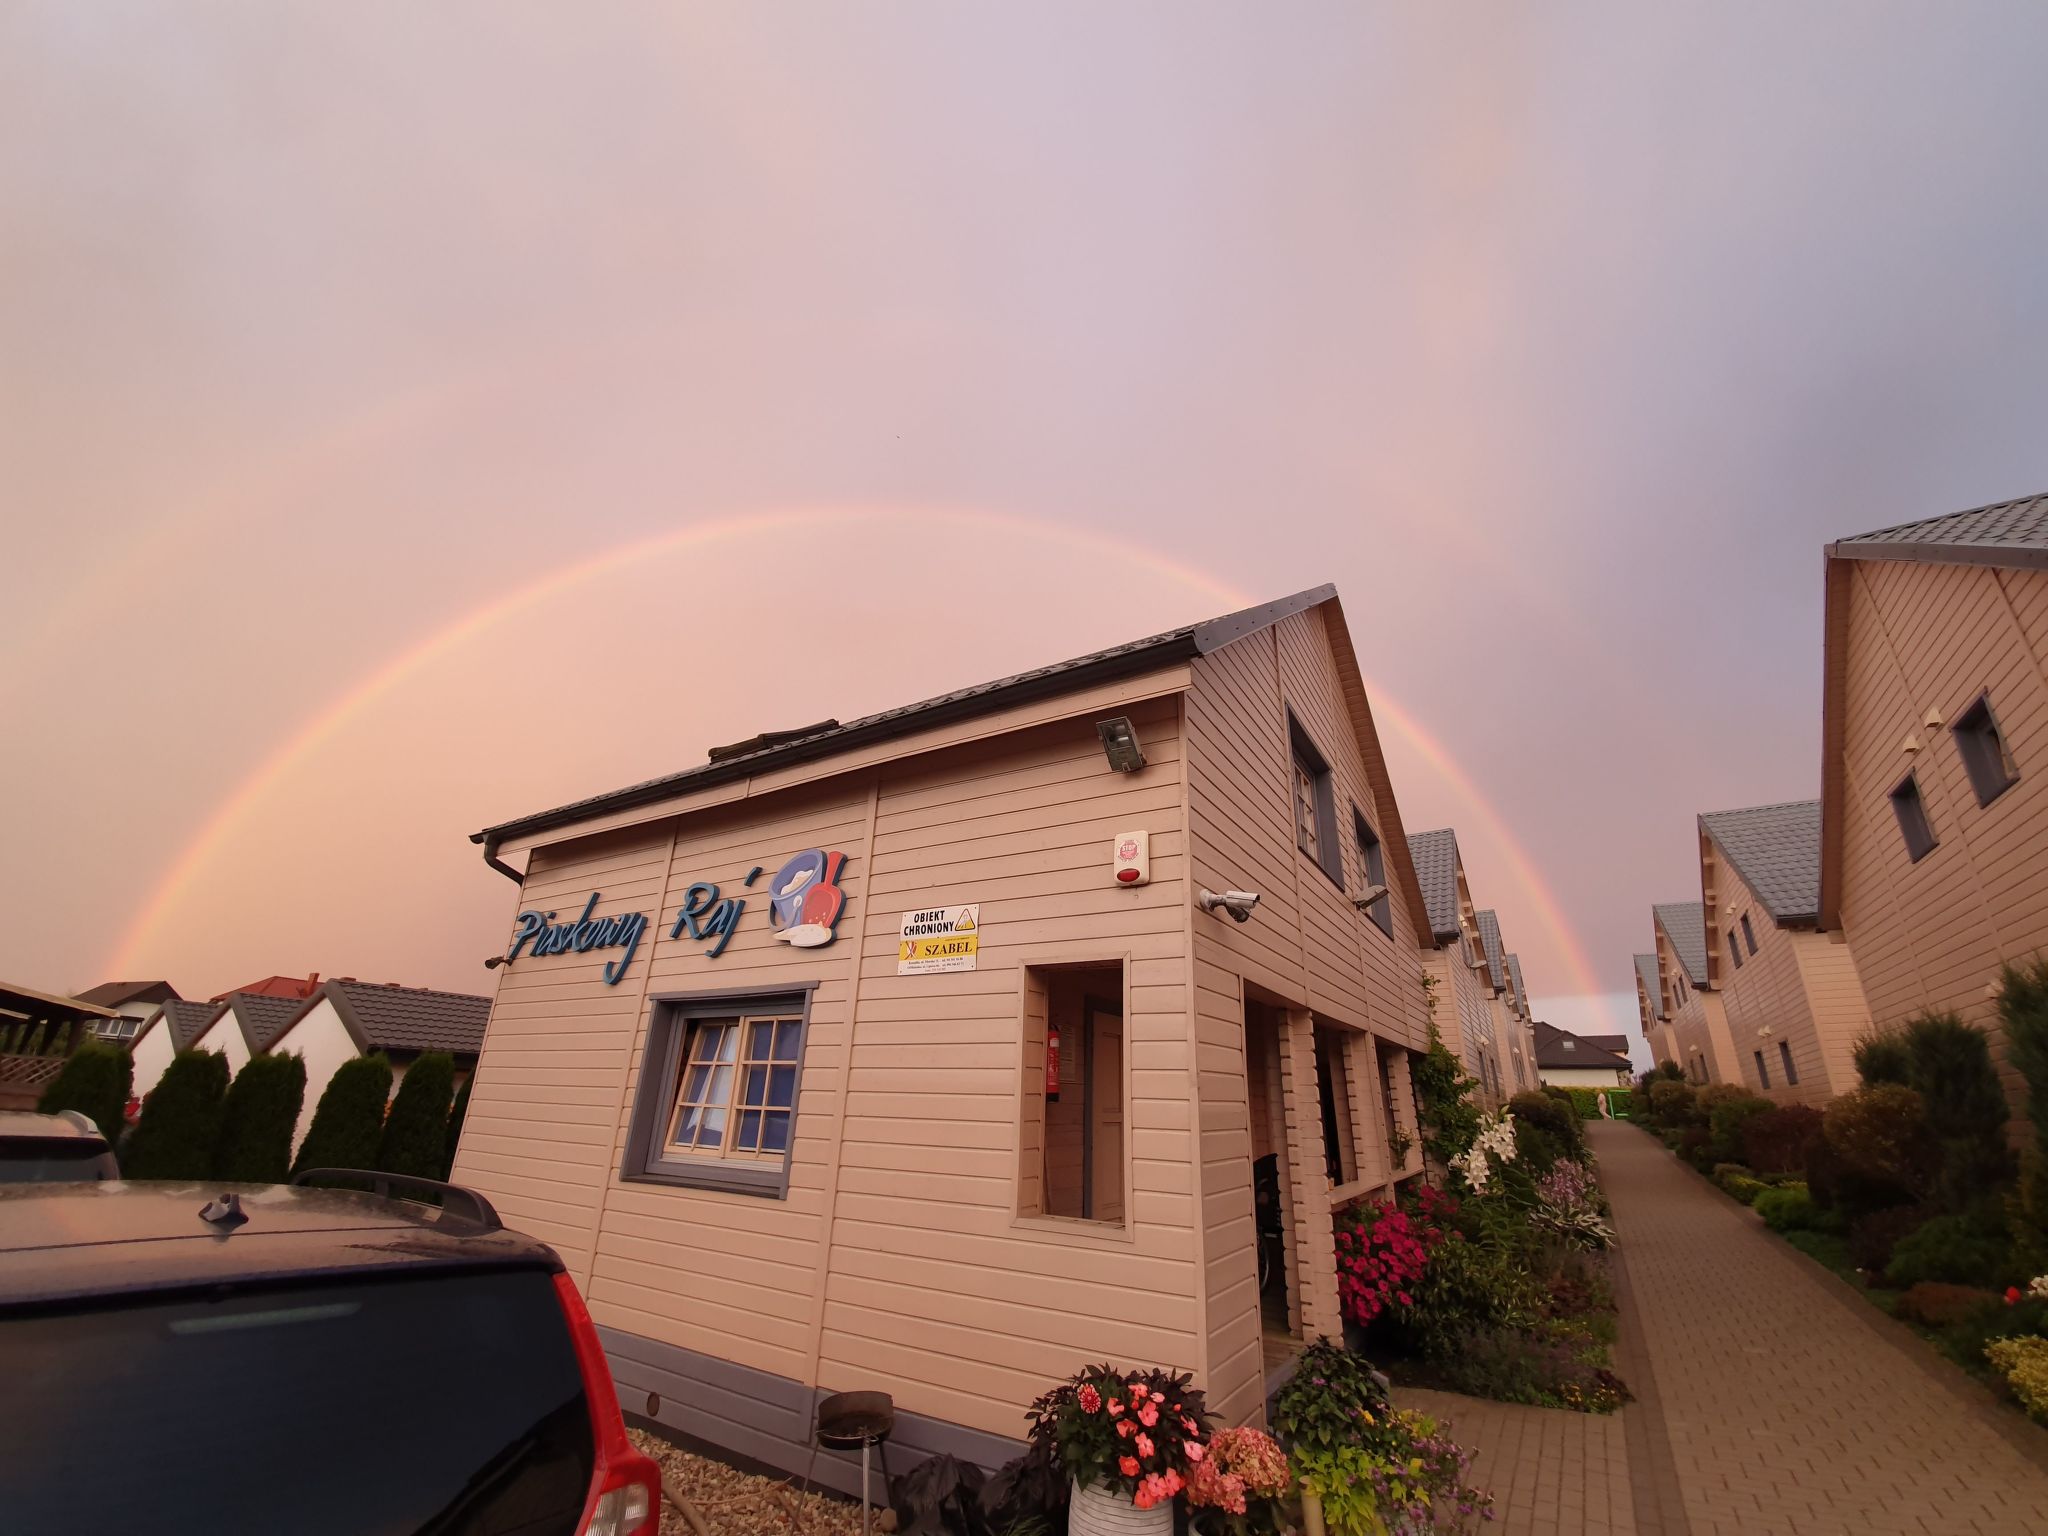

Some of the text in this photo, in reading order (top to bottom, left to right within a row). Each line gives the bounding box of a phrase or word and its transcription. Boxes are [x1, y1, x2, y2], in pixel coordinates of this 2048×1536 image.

[913, 910, 945, 923] OBIEKT
[508, 866, 763, 985] Piaskowy Raj
[904, 921, 954, 936] CHRONIONY
[925, 941, 972, 956] SZABEL
